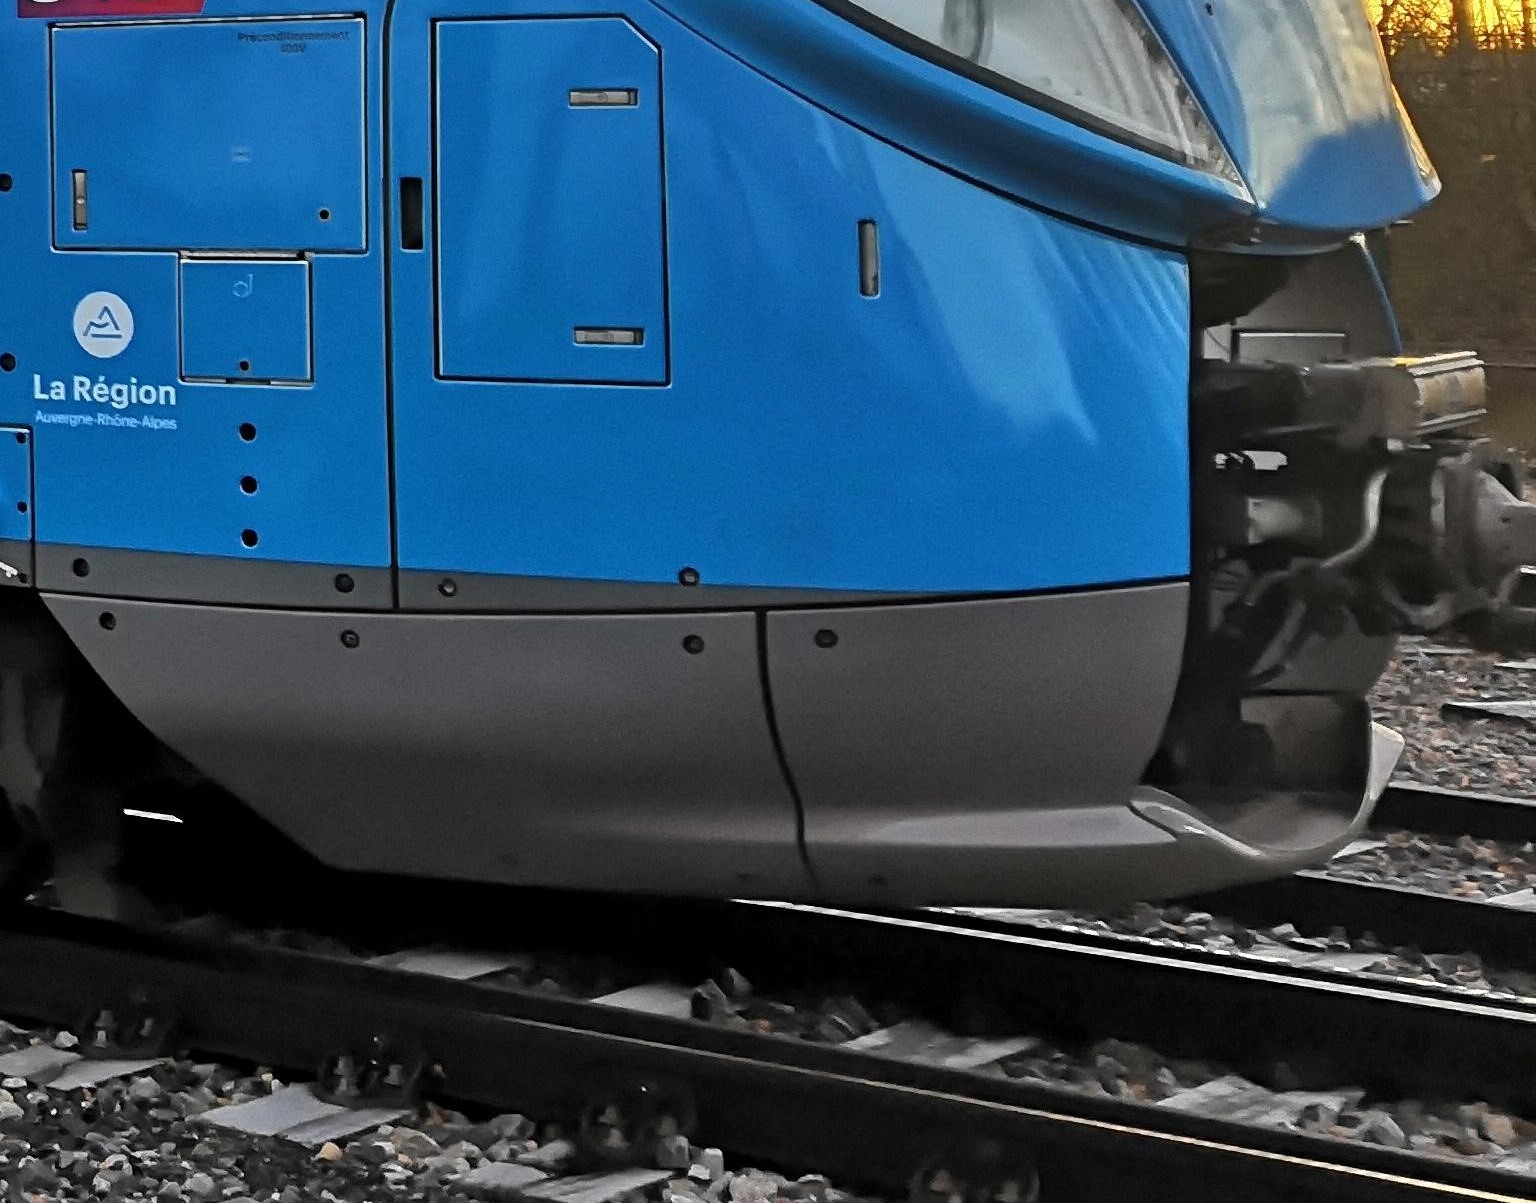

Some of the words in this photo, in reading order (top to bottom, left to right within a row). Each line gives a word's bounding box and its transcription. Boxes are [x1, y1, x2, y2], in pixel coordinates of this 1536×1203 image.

[33, 373, 66, 401] La
[73, 375, 177, 409] Région
[34, 409, 178, 431] Auvergne-Rhône-Alpes
